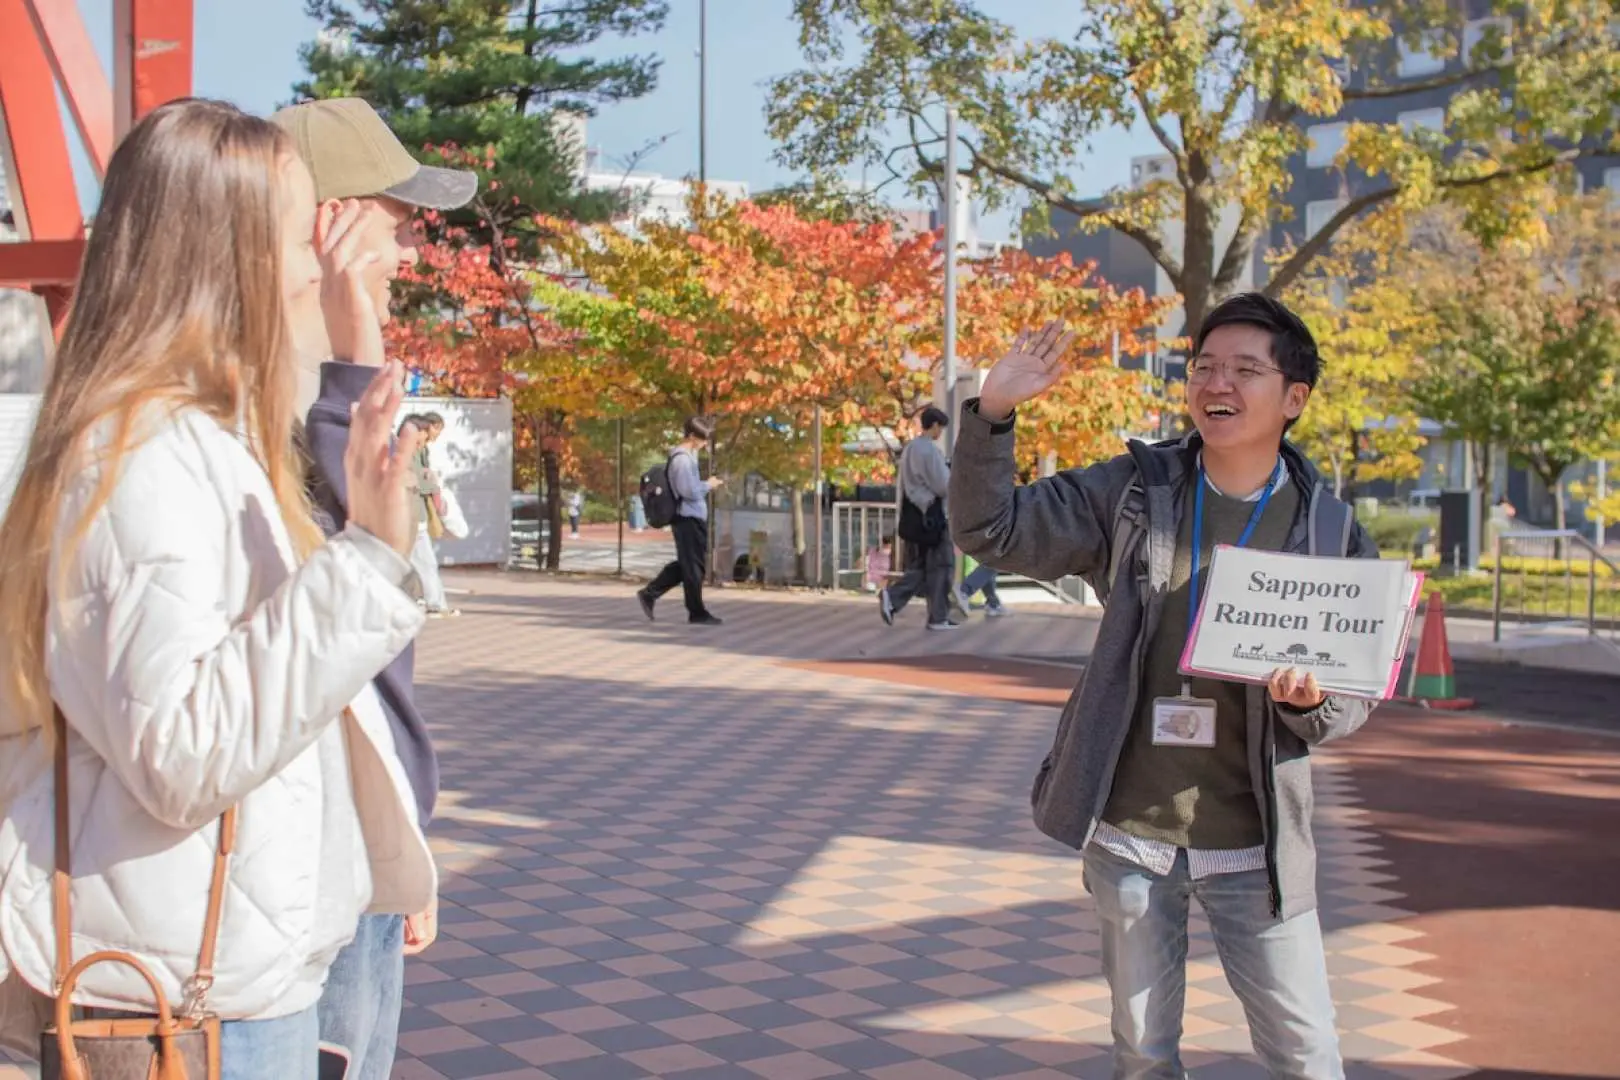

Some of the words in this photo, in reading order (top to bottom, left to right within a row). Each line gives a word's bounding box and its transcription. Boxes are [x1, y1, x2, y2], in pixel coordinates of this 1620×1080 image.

[1247, 571, 1361, 602] Sapporo
[1213, 602, 1308, 631] Ramen
[1319, 610, 1384, 634] Tour
